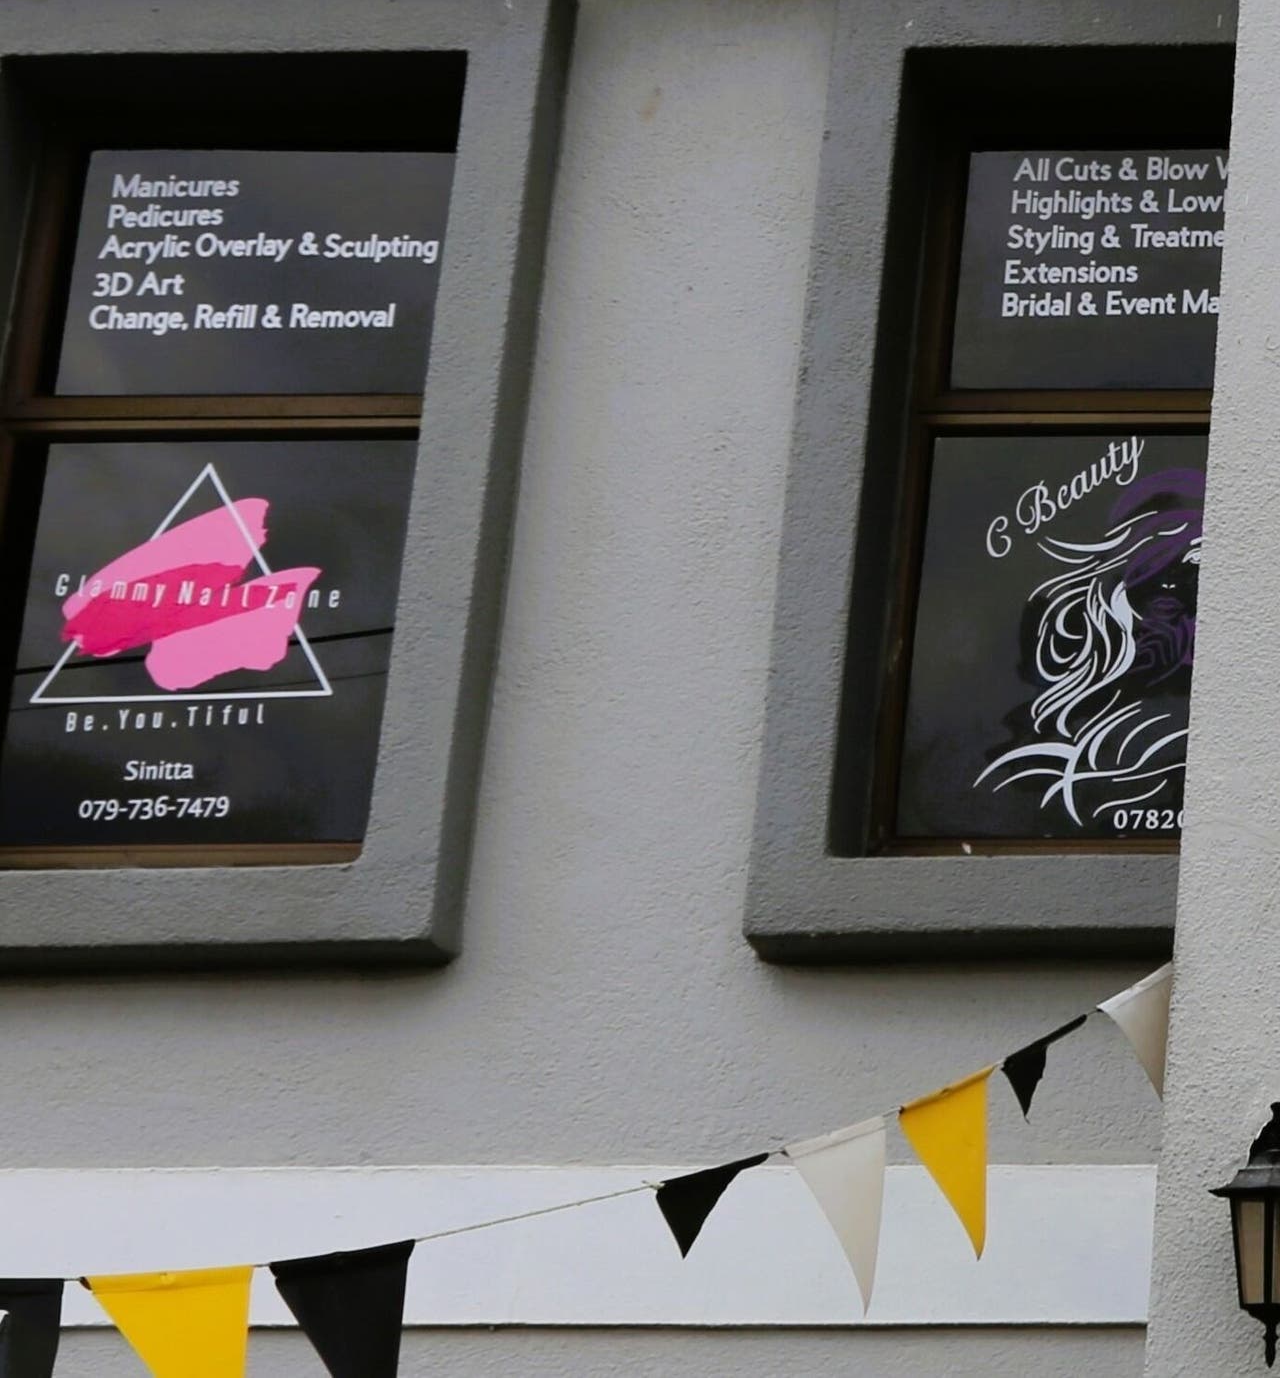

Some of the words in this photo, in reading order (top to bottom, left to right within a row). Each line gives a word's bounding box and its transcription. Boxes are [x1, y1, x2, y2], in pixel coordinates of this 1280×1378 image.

[1013, 158, 1050, 182] All
[1055, 157, 1112, 181] Cuts
[1118, 157, 1138, 181] &
[1146, 157, 1209, 180] Blow
[111, 174, 240, 199] Manicures
[106, 204, 224, 229] Pedicures
[1011, 189, 1133, 220] Highlights
[1140, 189, 1159, 214] &
[98, 235, 191, 264] Acrylic
[195, 233, 294, 262] Overlay
[298, 231, 319, 256] &
[323, 234, 440, 264] Sculpting
[1006, 225, 1095, 255] Styling
[1101, 225, 1121, 248] &
[92, 272, 133, 297] 3D
[136, 272, 185, 297] Art
[1004, 260, 1138, 284] Extensions
[1001, 292, 1072, 317] Bridal
[1077, 292, 1099, 316] &
[1105, 290, 1176, 315] Event
[88, 304, 189, 335] Change,
[193, 304, 257, 330] Refill
[261, 304, 283, 329] &
[289, 303, 397, 329] Removal
[1015, 435, 1145, 534] Beauty
[55, 573, 166, 608] Glammy
[178, 580, 250, 608] Nail
[265, 585, 341, 610] Zone
[123, 760, 195, 782] Sinitta
[78, 795, 230, 821] 079-736-7479
